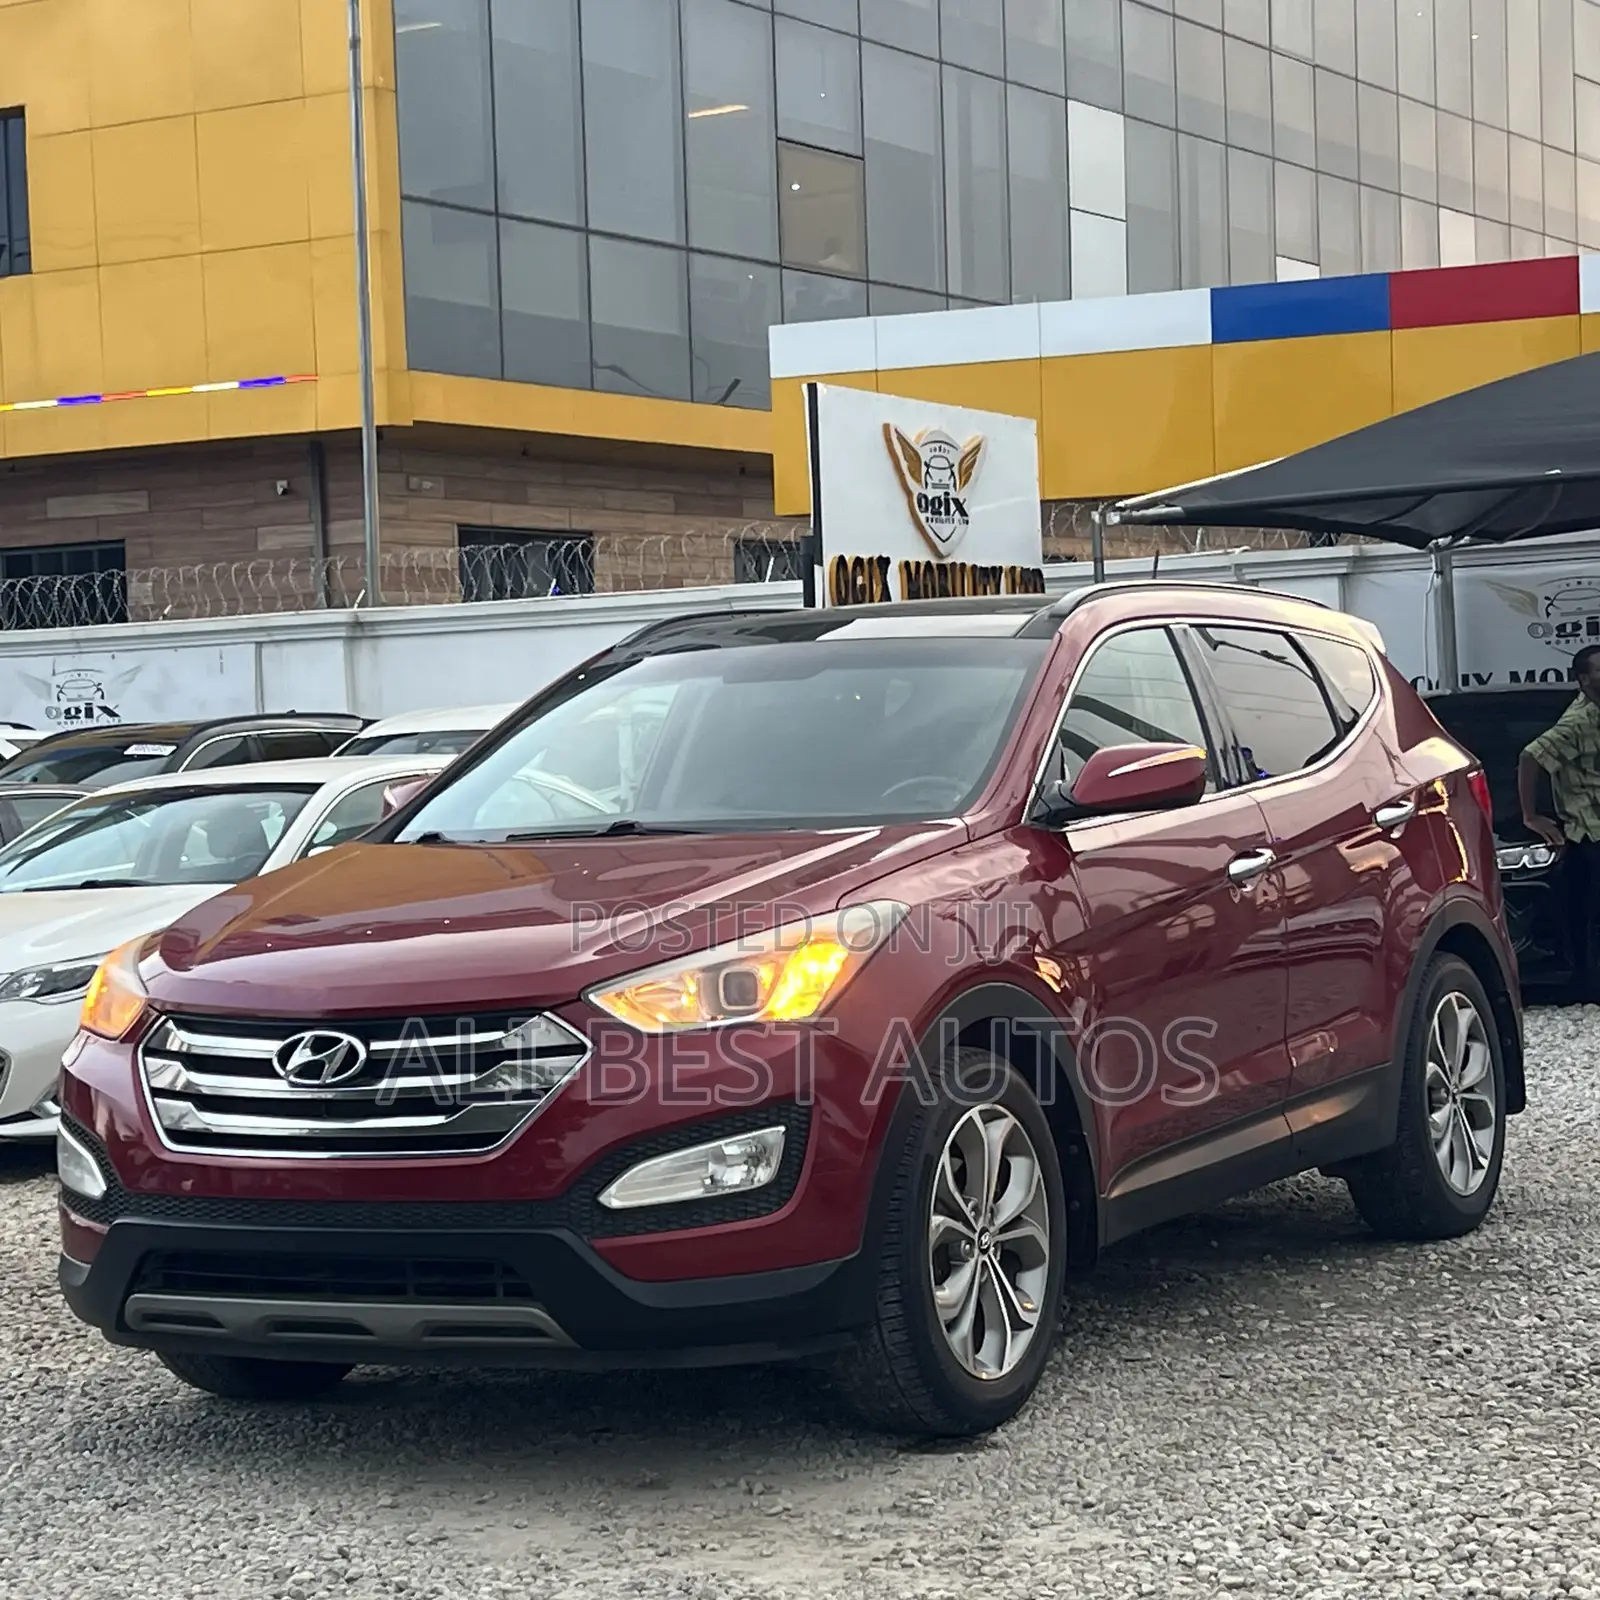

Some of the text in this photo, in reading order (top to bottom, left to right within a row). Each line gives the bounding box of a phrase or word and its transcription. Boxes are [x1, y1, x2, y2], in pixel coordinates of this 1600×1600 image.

[917, 492, 969, 517] ogix
[829, 554, 893, 607] OGIX
[45, 702, 121, 720] ogix
